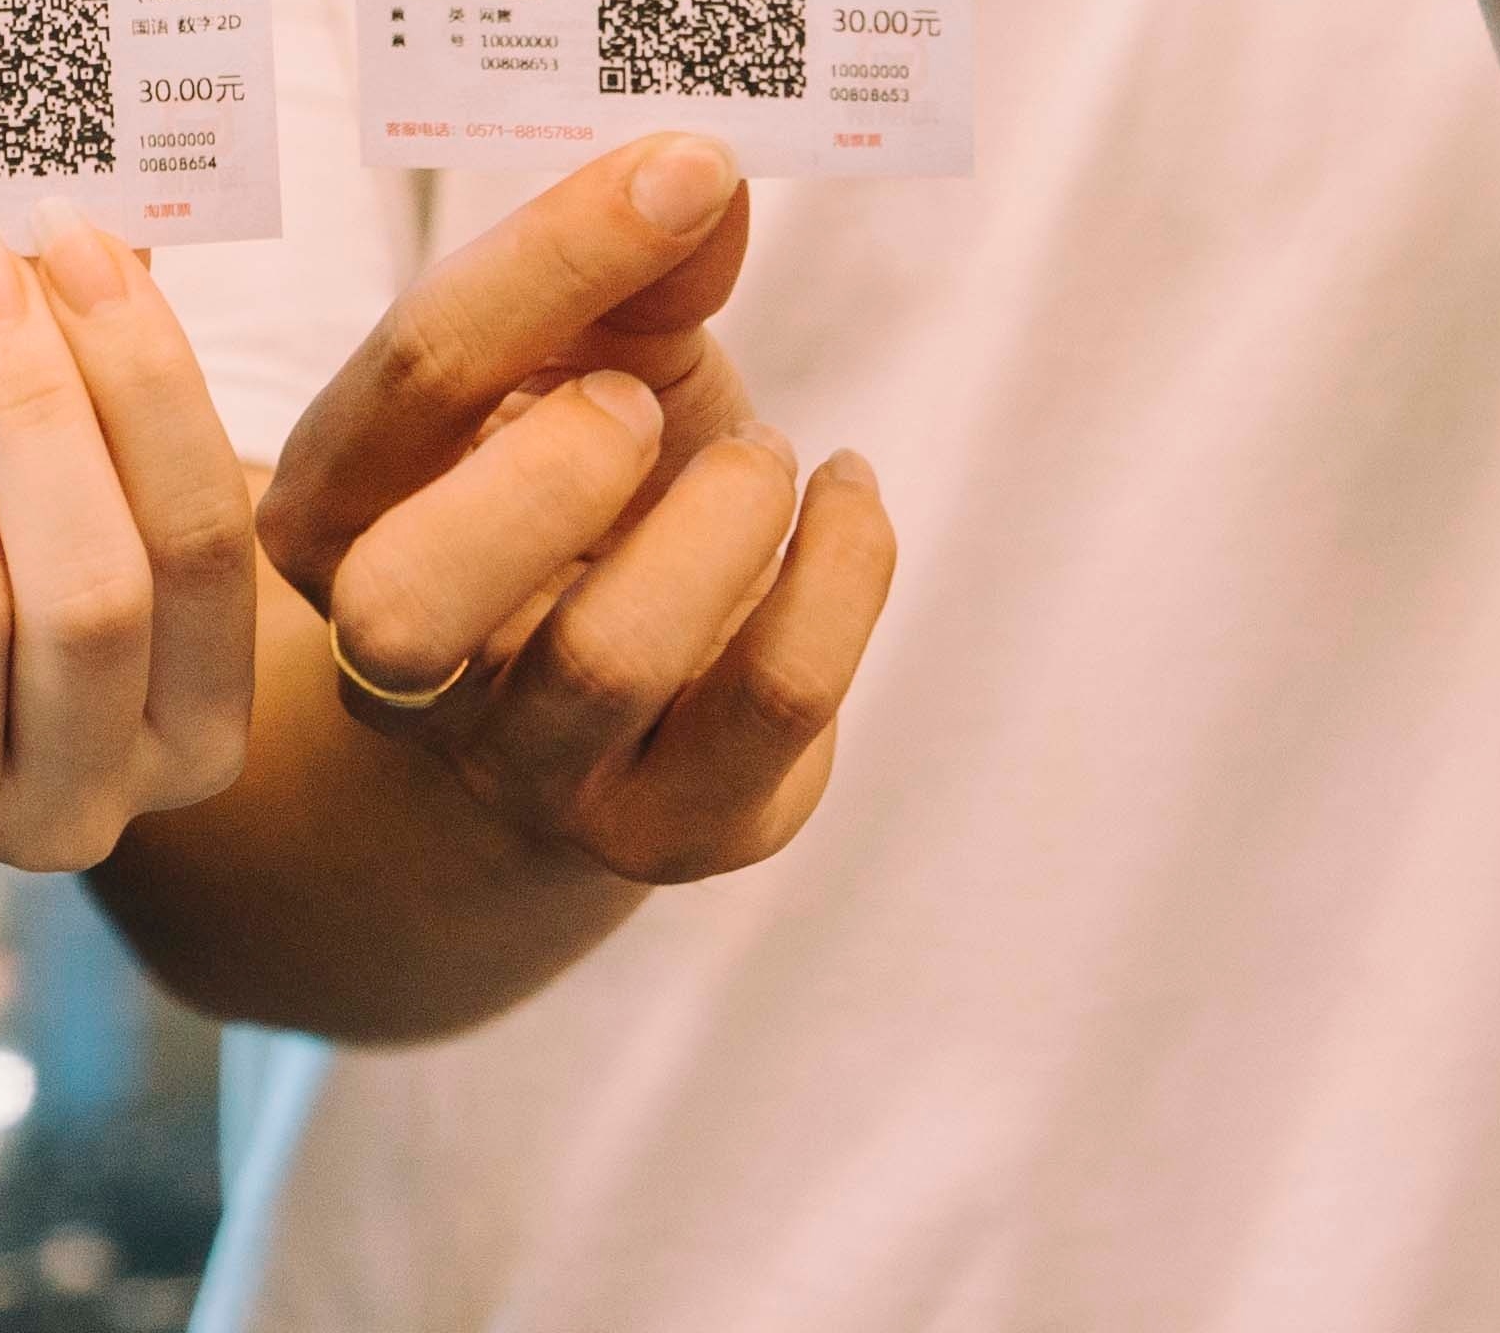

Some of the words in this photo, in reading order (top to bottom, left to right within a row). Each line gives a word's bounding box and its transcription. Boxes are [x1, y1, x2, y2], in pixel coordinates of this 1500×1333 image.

[832, 8, 942, 38] 30.00元
[830, 63, 911, 79] 10000000
[138, 74, 246, 104] 30.00元
[138, 131, 217, 149] 10000000
[138, 155, 218, 173] 00808654
